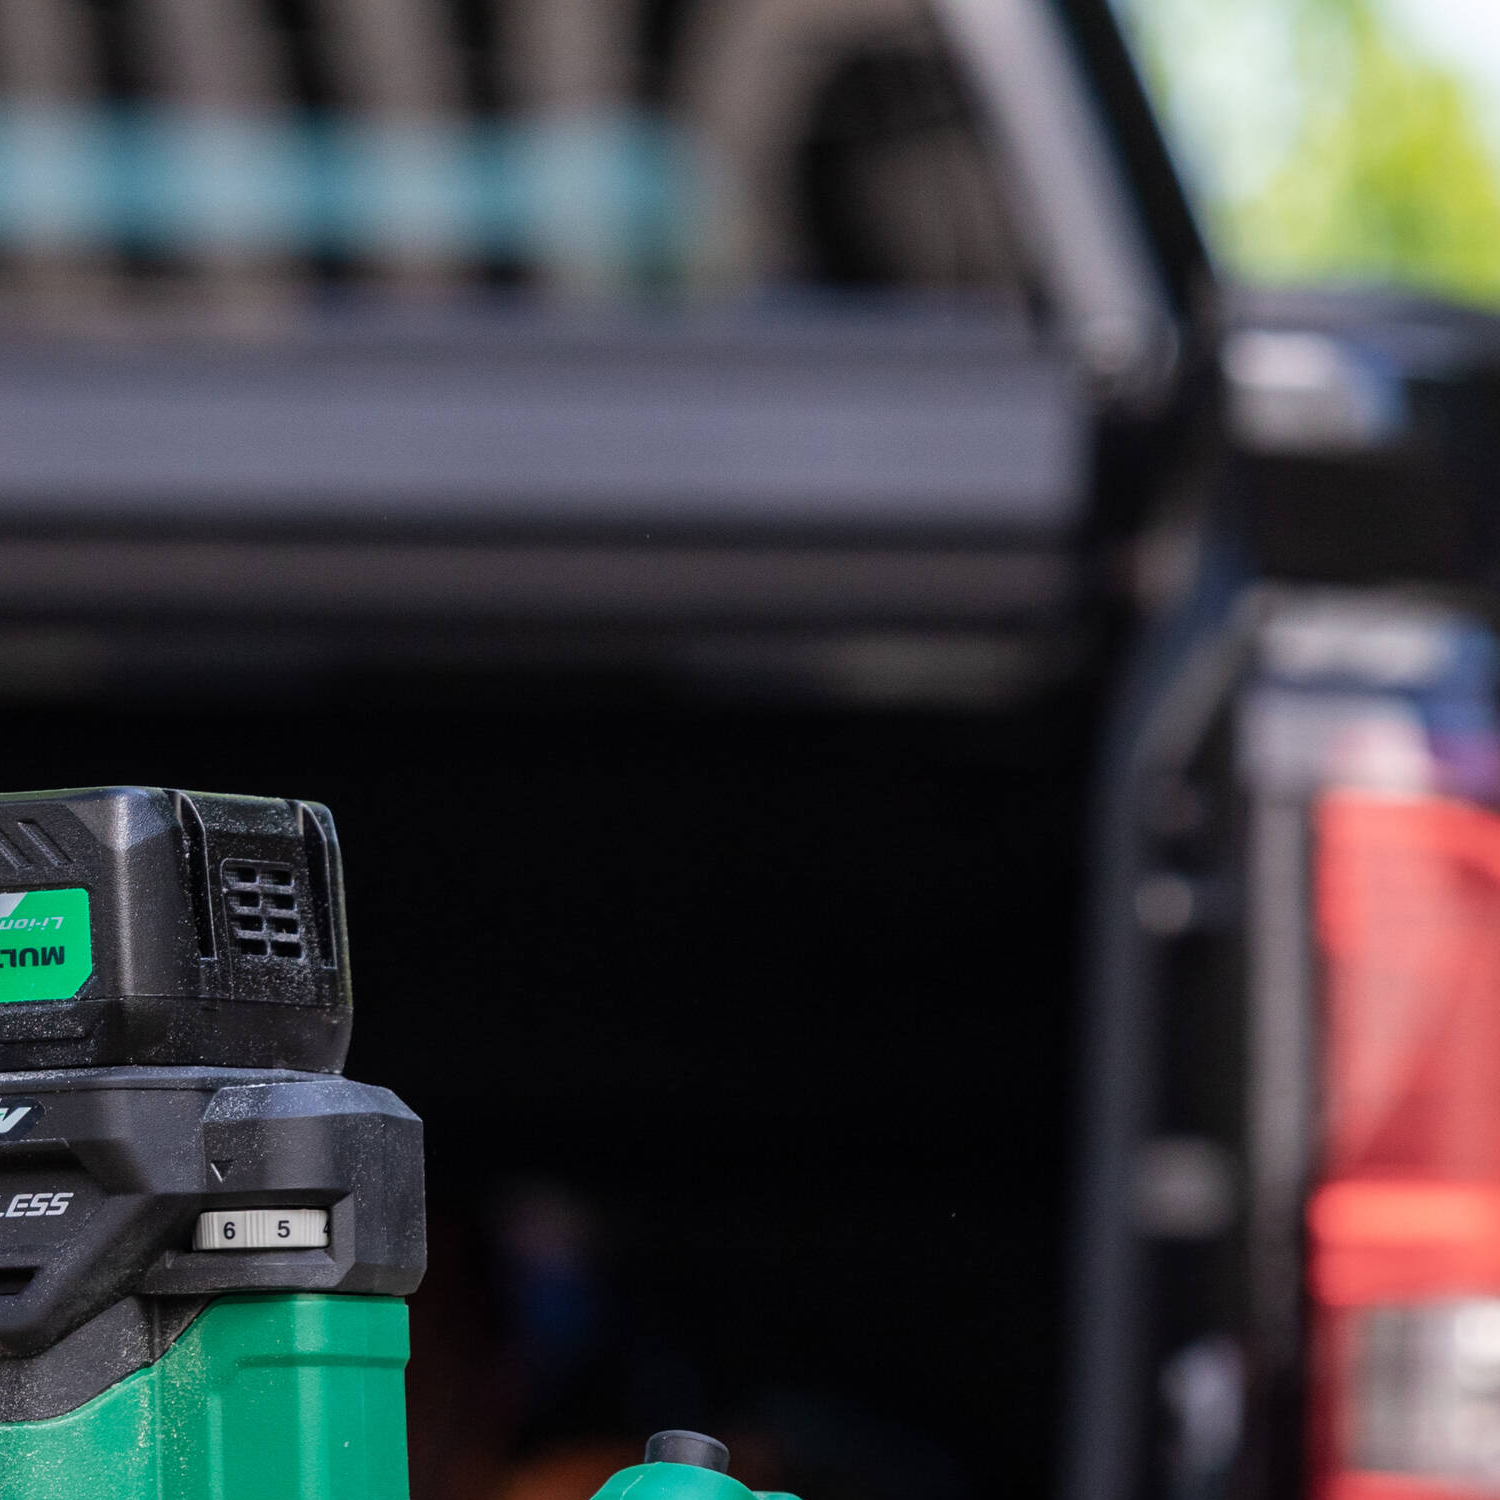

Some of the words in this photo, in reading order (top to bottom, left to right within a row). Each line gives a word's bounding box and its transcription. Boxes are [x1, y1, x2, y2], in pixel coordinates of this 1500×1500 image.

[0, 916, 64, 931] Li-ion
[223, 1221, 236, 1239] 6
[277, 1220, 291, 1238] 5
